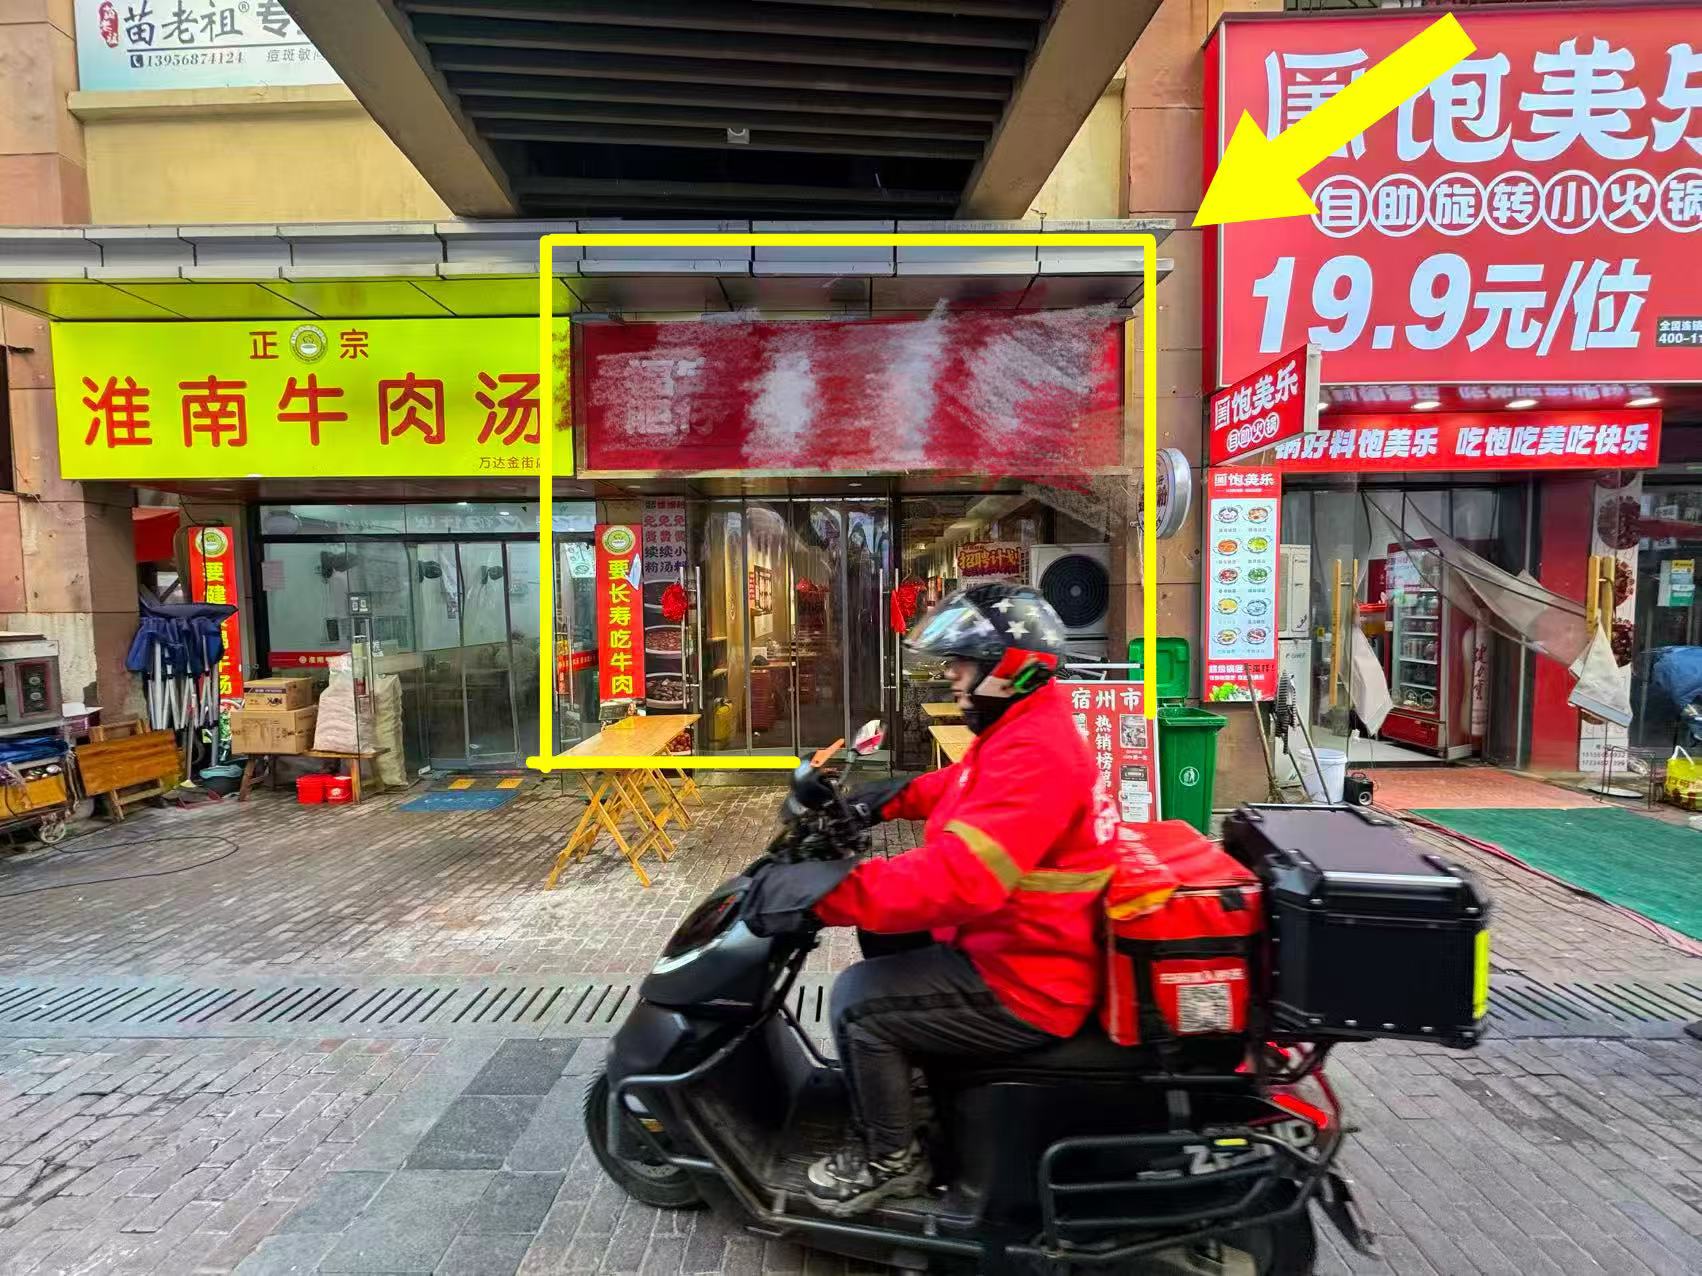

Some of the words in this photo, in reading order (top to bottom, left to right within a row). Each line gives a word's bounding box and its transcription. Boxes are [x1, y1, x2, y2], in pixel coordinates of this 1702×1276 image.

[124, 0, 243, 46] 苗老祖
[147, 53, 243, 67] 13956874124
[1318, 178, 1702, 227] 自助旋转小火锅
[1252, 253, 1652, 357] 19.9元/位
[82, 371, 540, 447] 淮南牛肉汤
[1455, 422, 1650, 457] 吃饱吃美吃快乐
[608, 559, 633, 695] 要长寿吃牛肉
[1072, 687, 1142, 712] 宿州市
